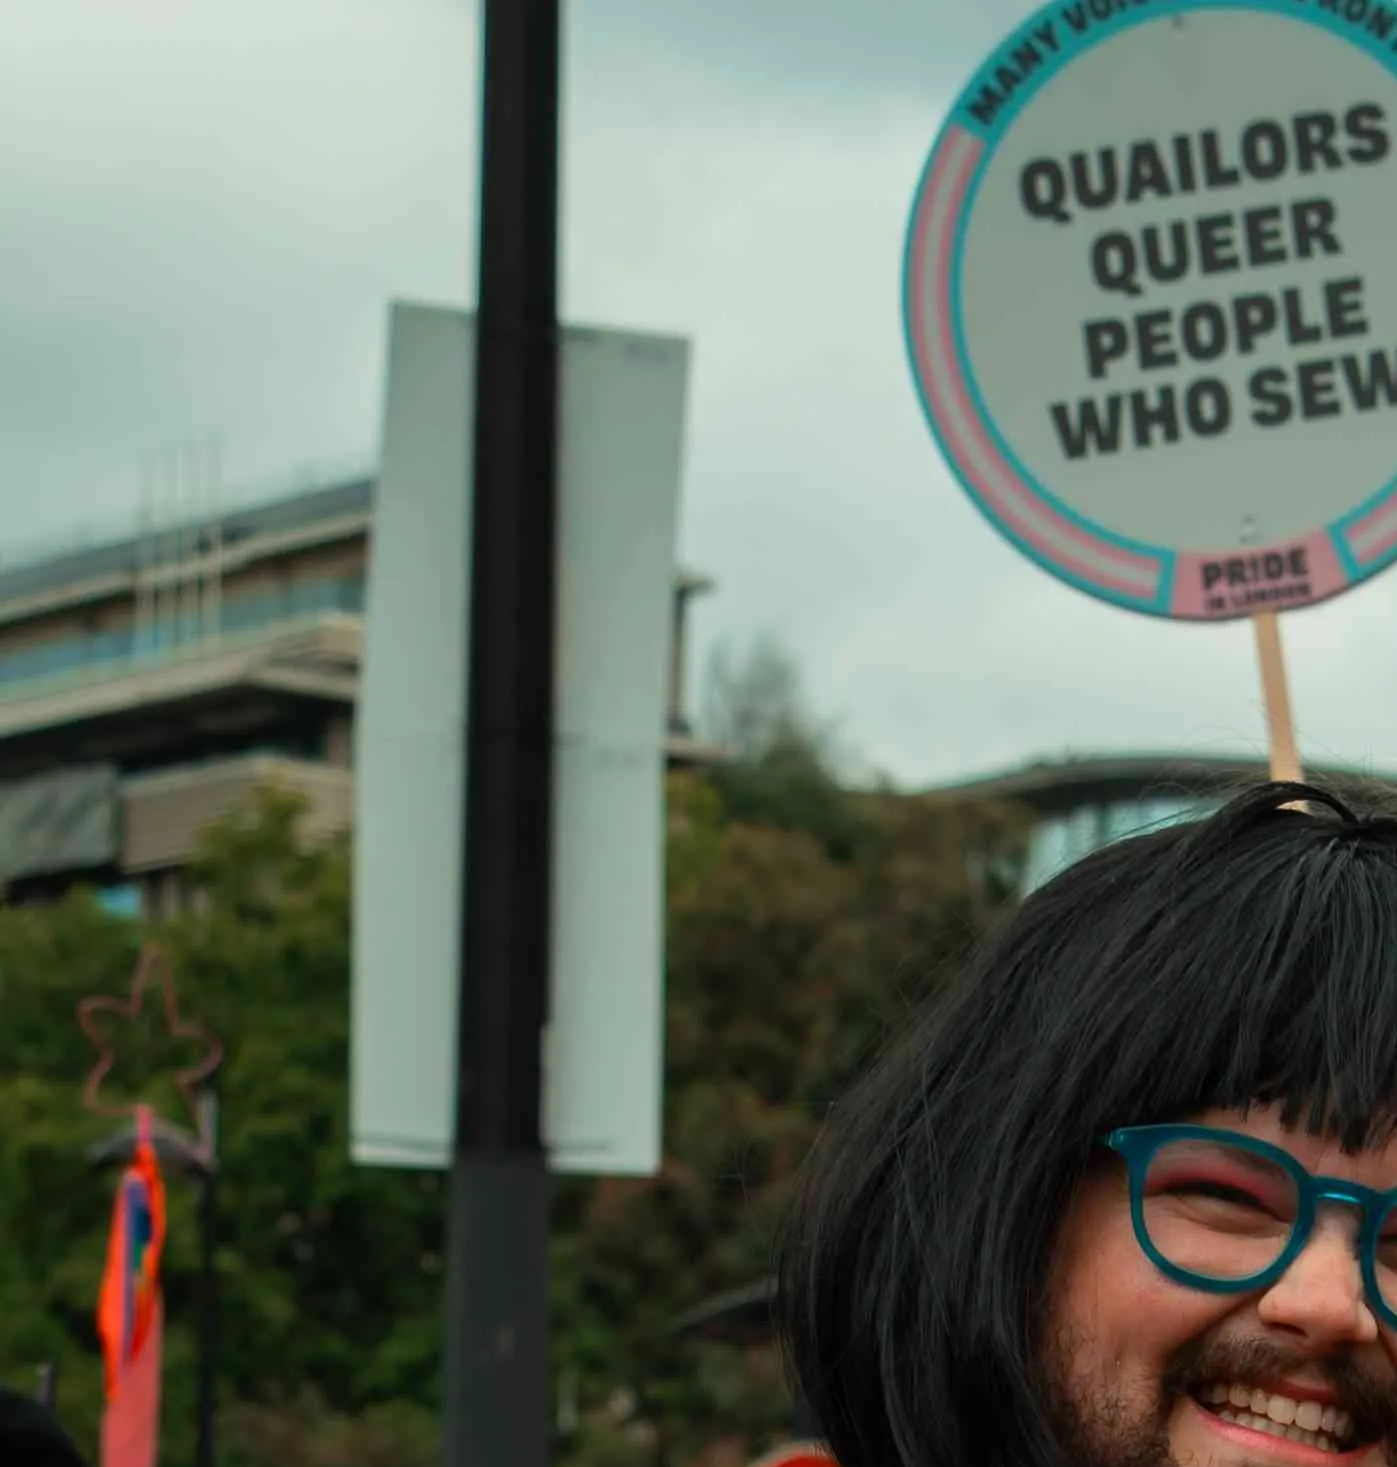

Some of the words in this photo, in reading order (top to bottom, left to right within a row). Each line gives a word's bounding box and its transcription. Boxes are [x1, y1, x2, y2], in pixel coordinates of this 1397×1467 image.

[1019, 102, 1390, 224] QUAILORS
[1091, 197, 1342, 298] QUEER
[1083, 278, 1370, 380] PEOPLE
[1049, 379, 1232, 462] WHO
[1202, 547, 1309, 590] PRIDE
